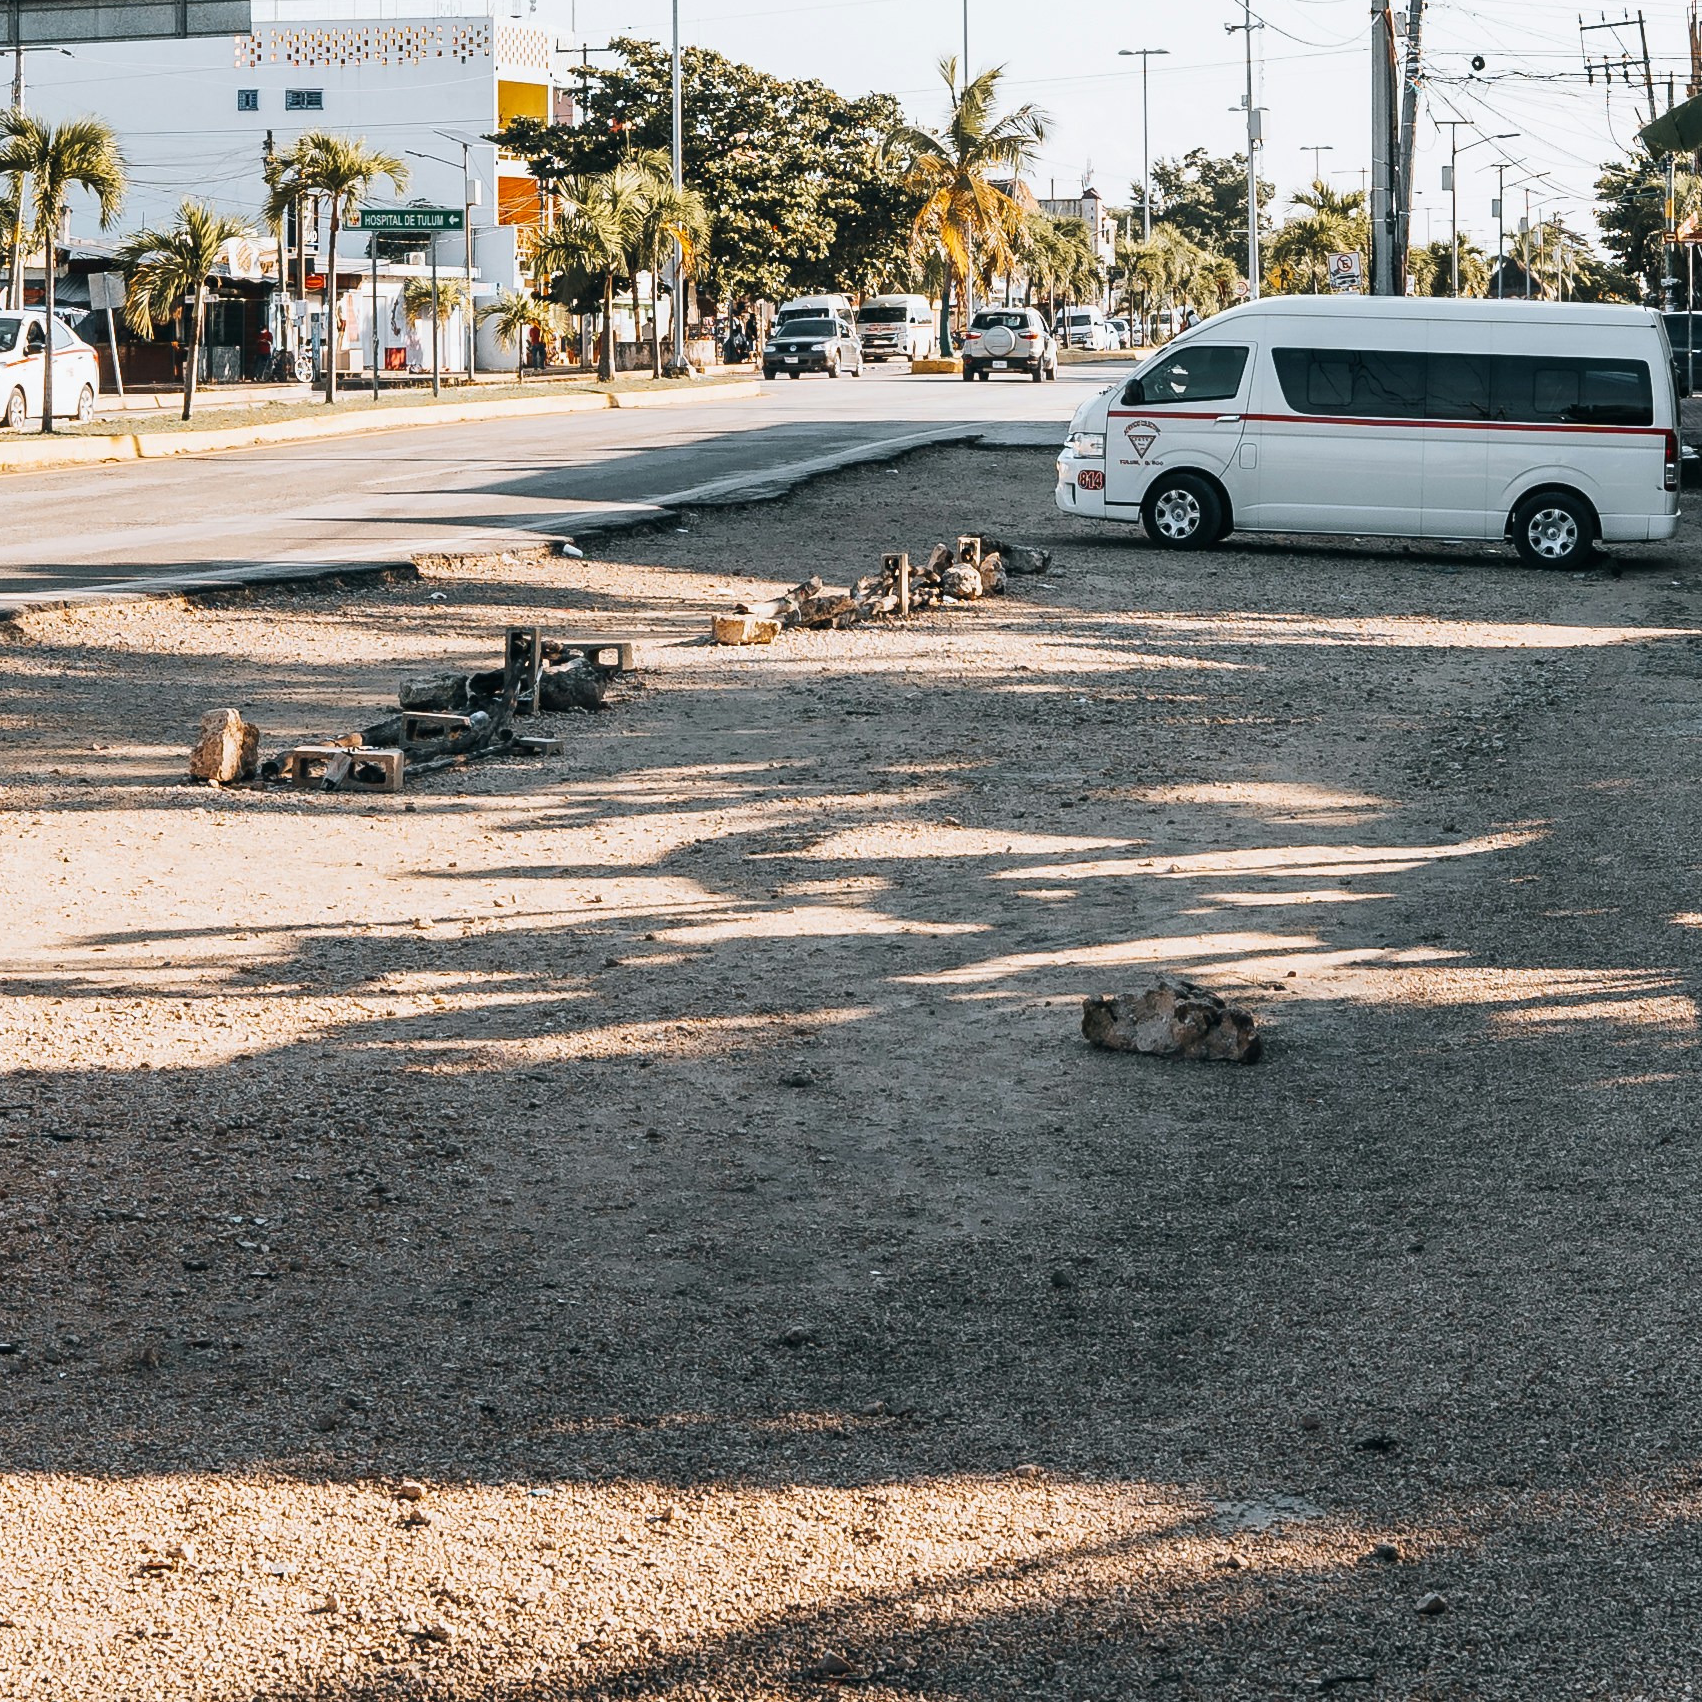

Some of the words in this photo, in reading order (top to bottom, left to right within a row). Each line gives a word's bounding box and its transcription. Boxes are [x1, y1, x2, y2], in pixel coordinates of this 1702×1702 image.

[365, 215, 403, 226] HOSPITAL
[405, 215, 416, 226] DE
[417, 215, 444, 226] TULUM
[1079, 470, 1102, 489] 814
